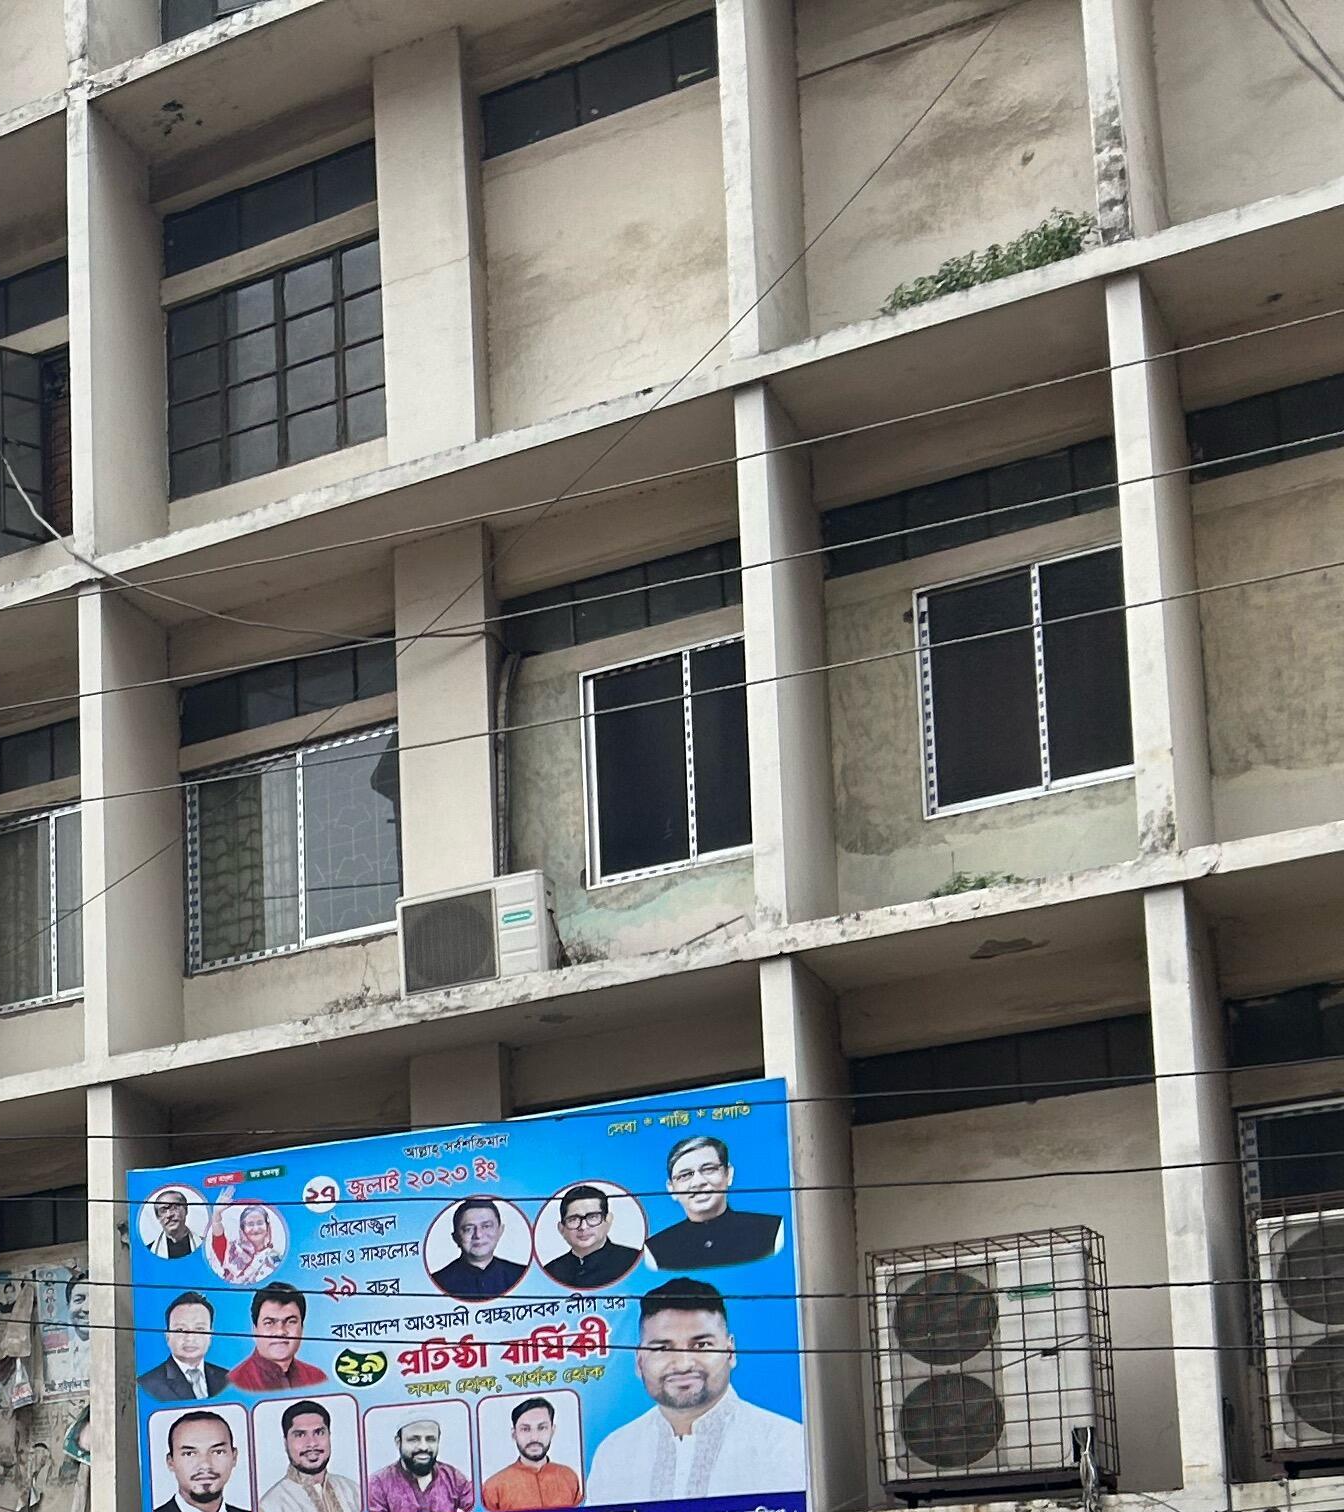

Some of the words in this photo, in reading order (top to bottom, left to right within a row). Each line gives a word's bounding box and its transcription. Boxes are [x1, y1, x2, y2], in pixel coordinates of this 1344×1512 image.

[346, 1170, 401, 1201] জুলাই
[407, 1165, 468, 1190] ২০২৩
[475, 1157, 499, 1180] ইং
[305, 1185, 336, 1203] ২৭
[319, 1214, 397, 1239] গৌরবোজ্জ্বল
[300, 1251, 341, 1270] সংগ্রাম
[344, 1250, 355, 1263] ও
[360, 1241, 419, 1262] সাফল্যের
[324, 1275, 358, 1301] ২৯
[366, 1278, 400, 1296] বছর
[331, 1318, 399, 1340] বাংলাদেশ
[404, 1306, 469, 1332] আওয়ামী
[474, 1301, 560, 1325] স্বেচ্ছাসেবক
[566, 1293, 597, 1314] লীগ
[397, 1334, 489, 1376] প্রতিষ্ঠা
[500, 1316, 610, 1362] বার্ষিকী
[337, 1353, 385, 1376] ২৯
[347, 1373, 374, 1384] তম
[406, 1381, 451, 1397] সফল
[562, 1365, 606, 1384] হোক
